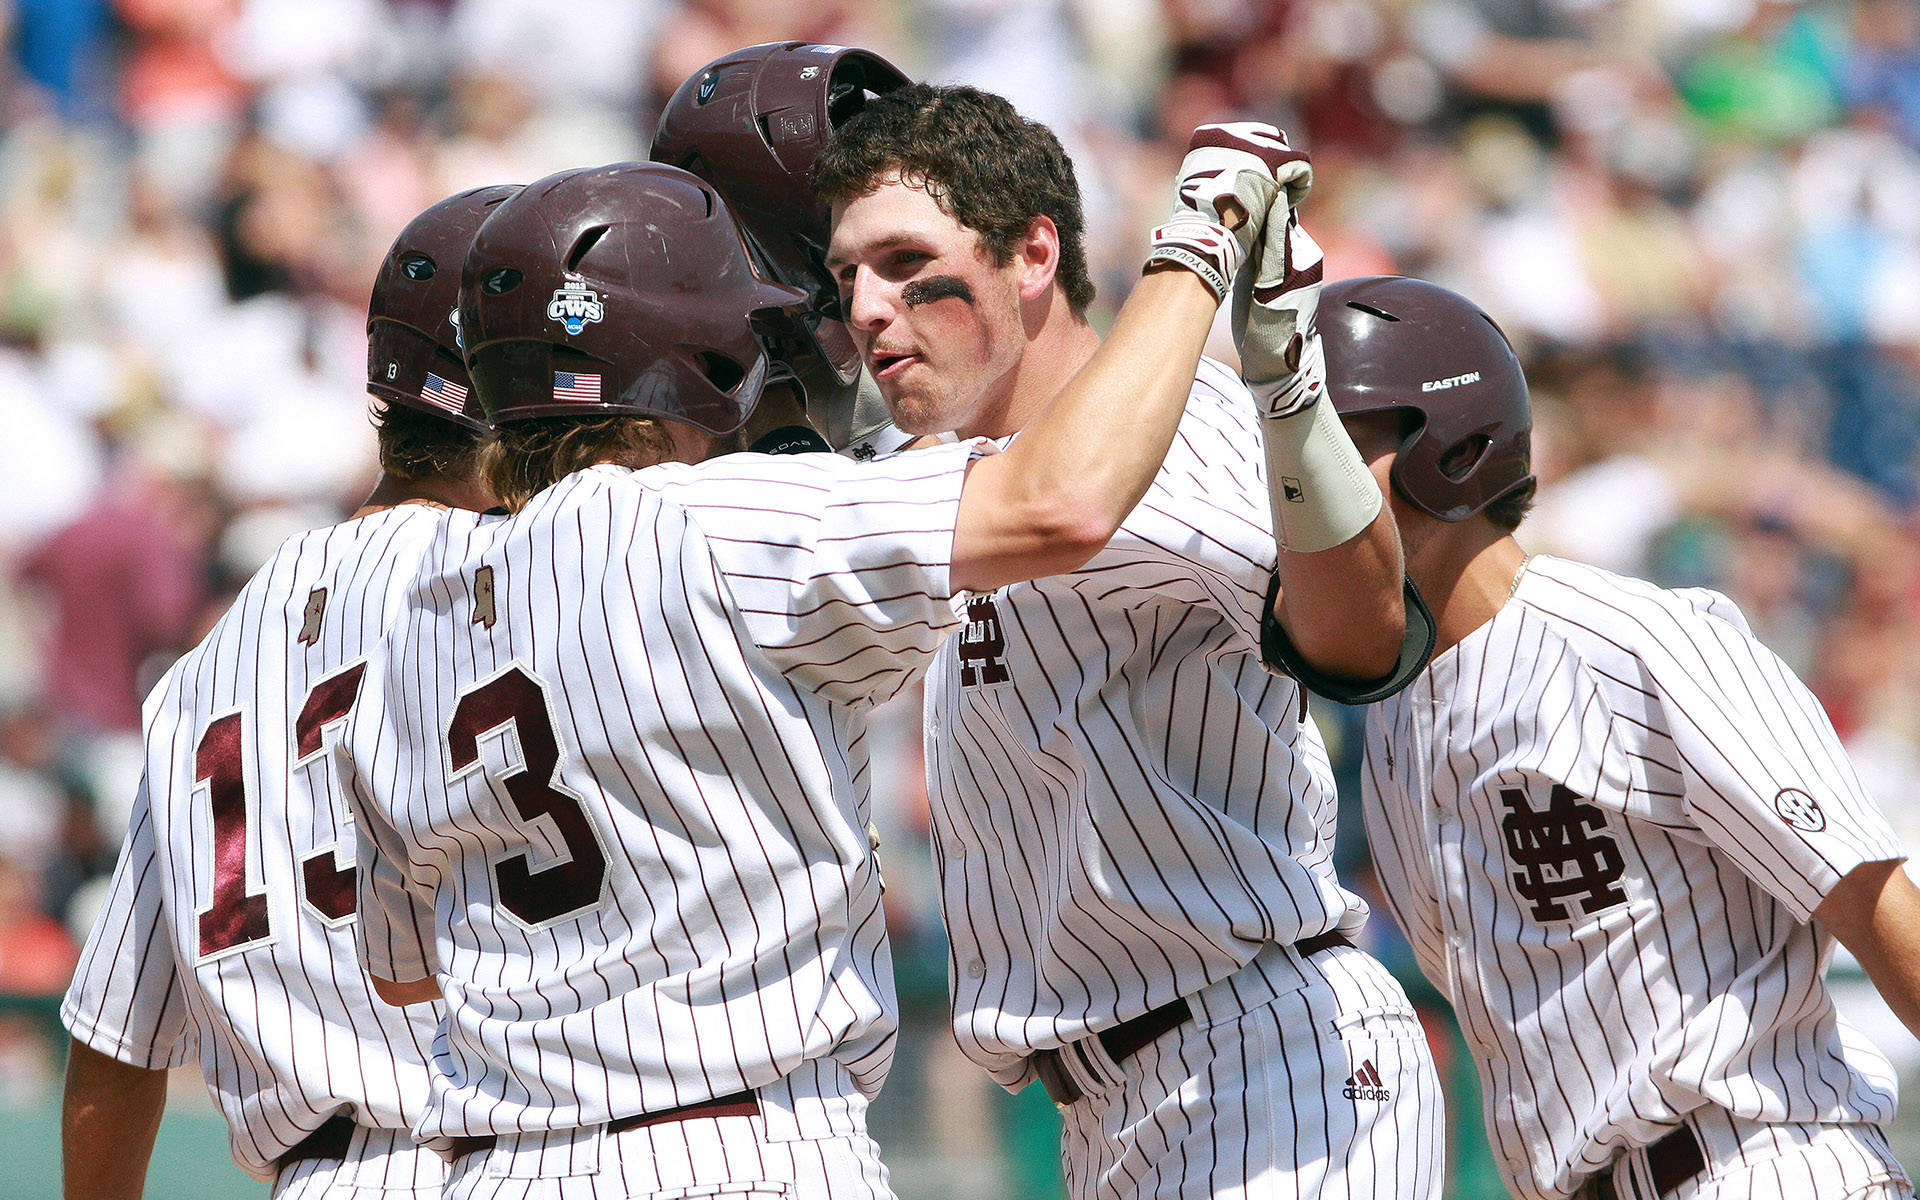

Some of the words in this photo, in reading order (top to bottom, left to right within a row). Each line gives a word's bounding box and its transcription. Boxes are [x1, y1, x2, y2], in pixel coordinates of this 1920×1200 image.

[799, 65, 819, 80] 34
[1177, 252, 1201, 268] YOU
[563, 281, 587, 291] 2013
[1202, 267, 1226, 296] HANK
[549, 299, 601, 321] CWS
[387, 362, 397, 380] 13
[1421, 371, 1481, 393] EASTON
[443, 658, 613, 936] 3
[1775, 788, 1826, 833] SEC
[1342, 1086, 1391, 1102] adidas
